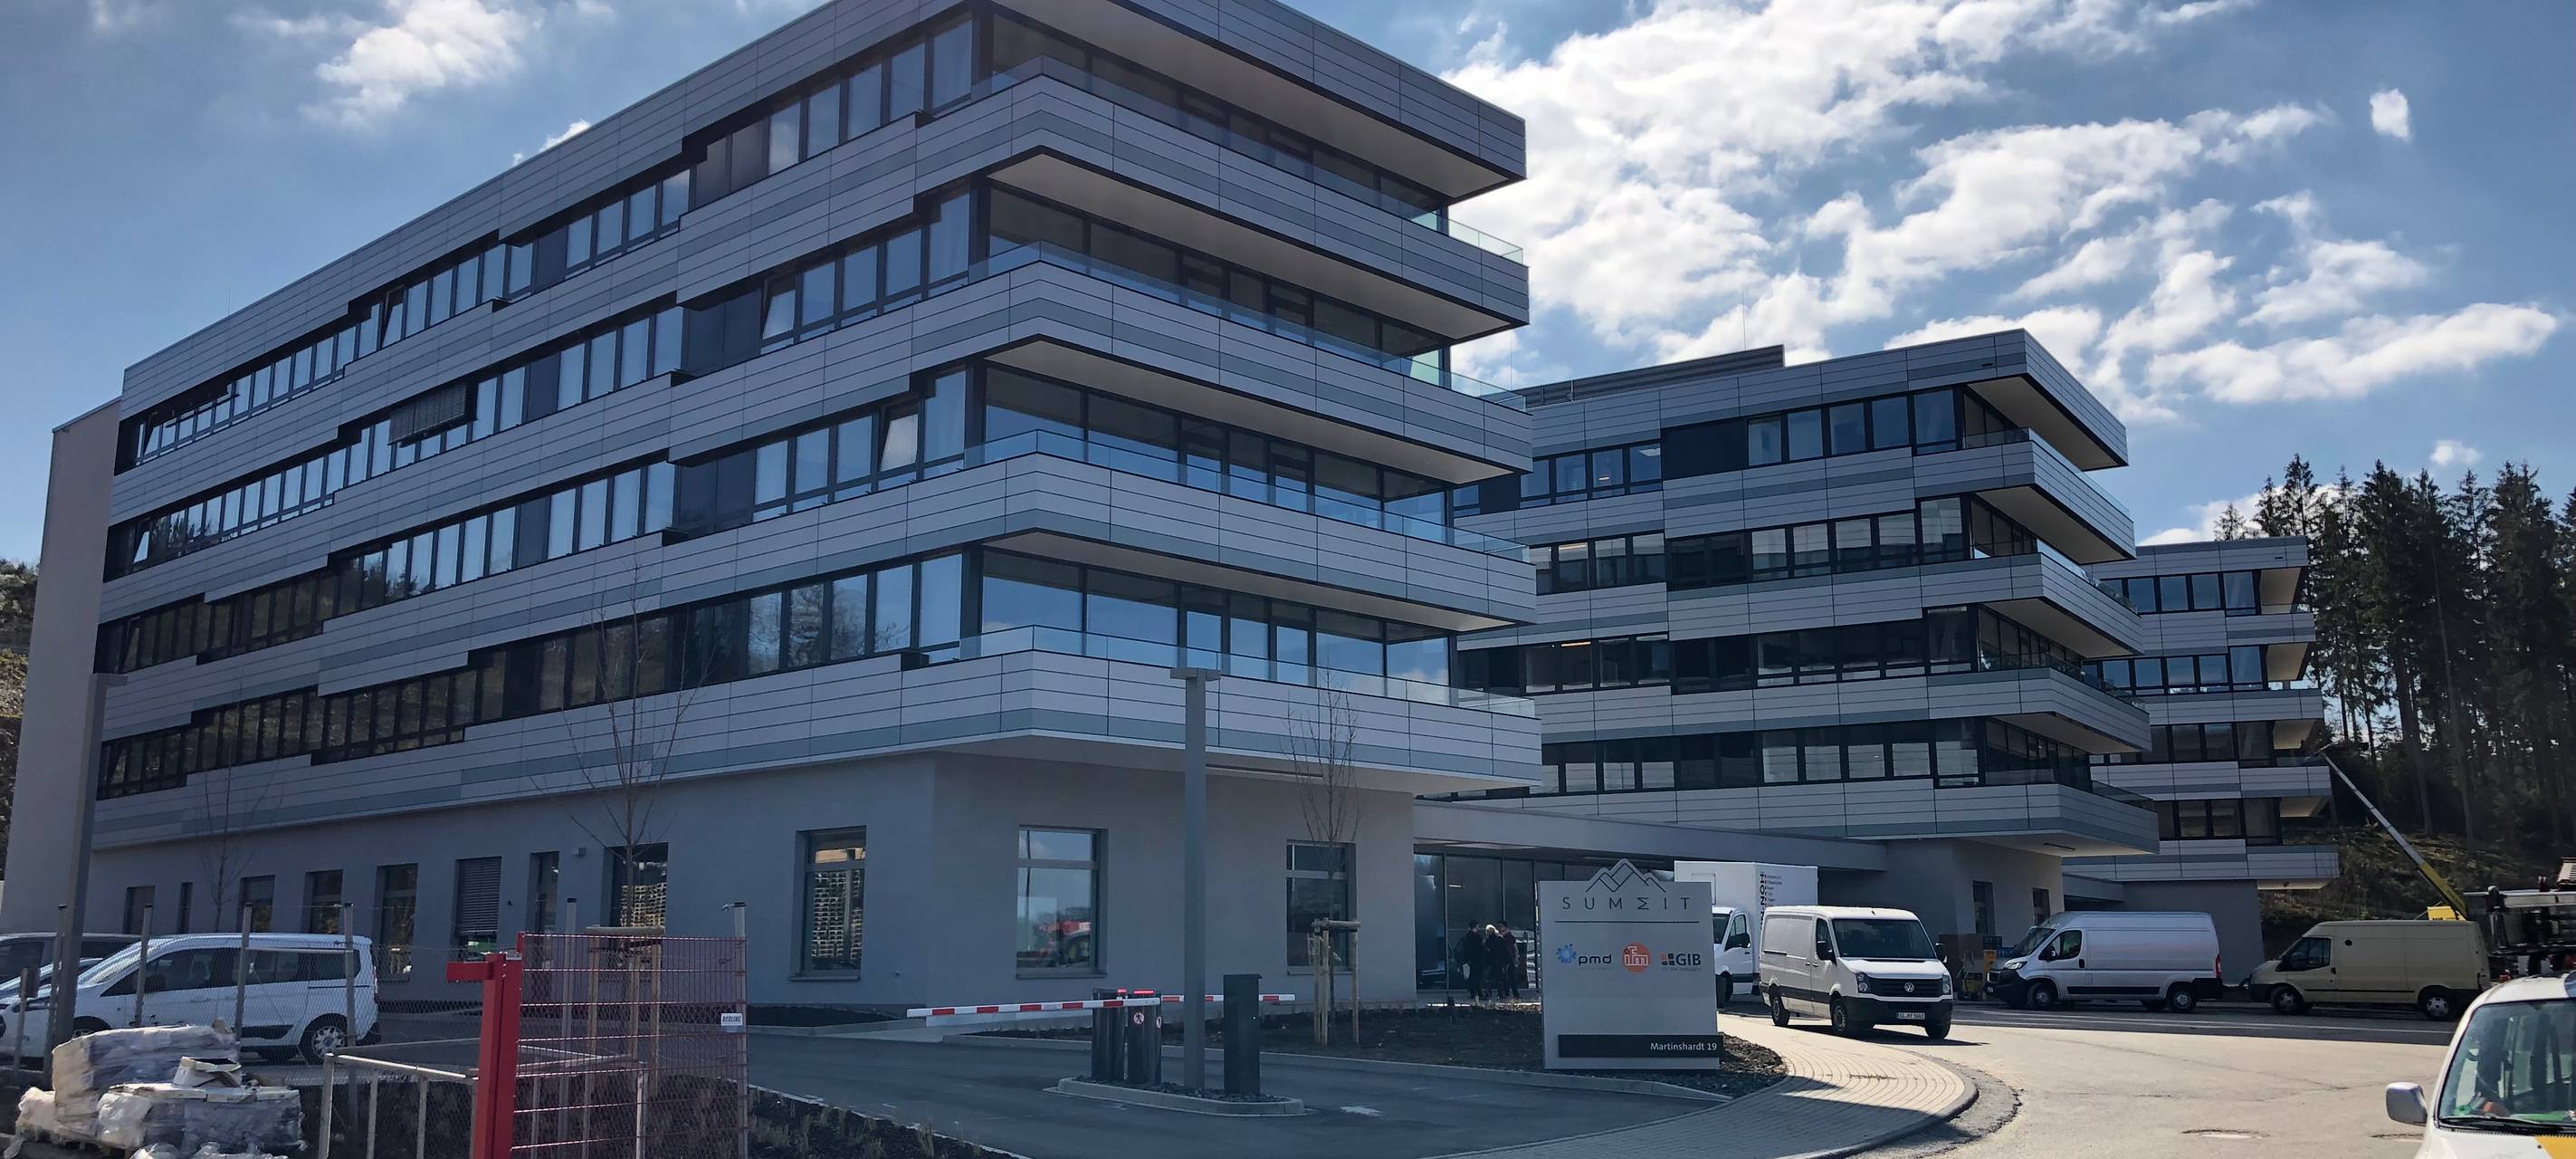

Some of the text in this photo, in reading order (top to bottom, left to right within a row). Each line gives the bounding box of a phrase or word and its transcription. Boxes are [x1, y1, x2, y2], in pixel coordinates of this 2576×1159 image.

[1578, 954, 1612, 966] pmd
[1623, 945, 1649, 966] ifm
[1675, 953, 1702, 966] GIB
[1650, 1042, 1718, 1051] Martinshardt 19
